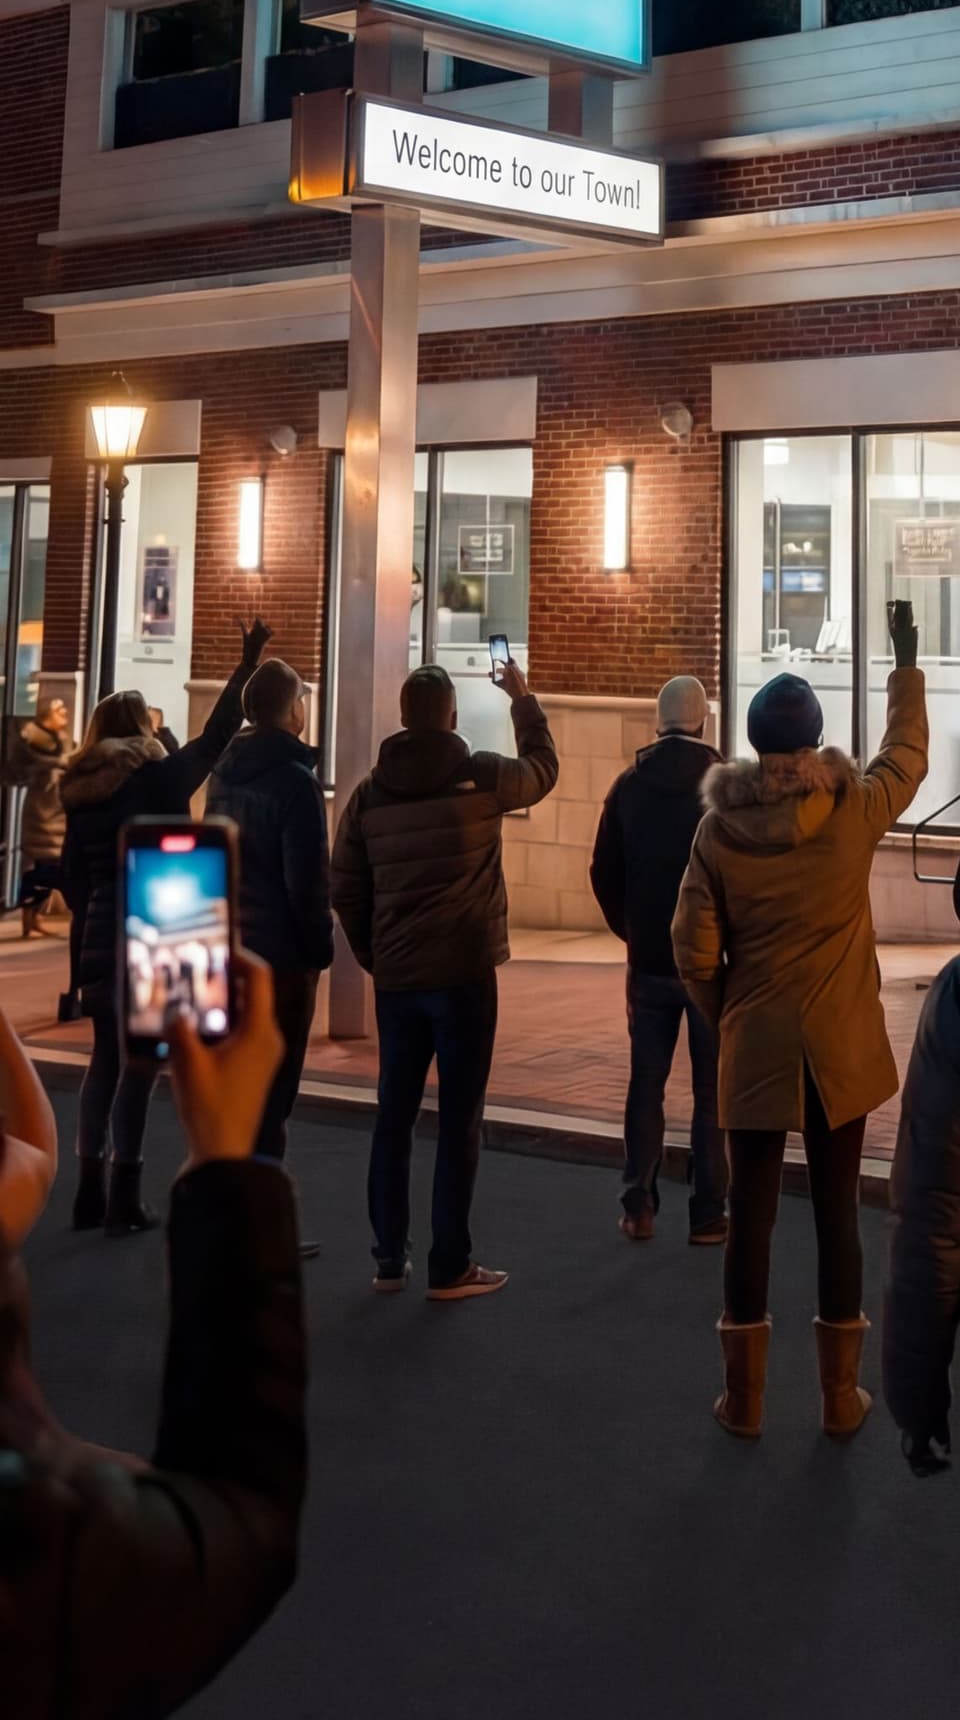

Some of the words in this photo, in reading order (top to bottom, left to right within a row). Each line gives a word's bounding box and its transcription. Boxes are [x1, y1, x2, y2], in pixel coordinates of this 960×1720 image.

[393, 129, 502, 183] Welcome
[512, 156, 532, 189] to
[541, 169, 575, 197] our
[583, 170, 640, 210] Town!
